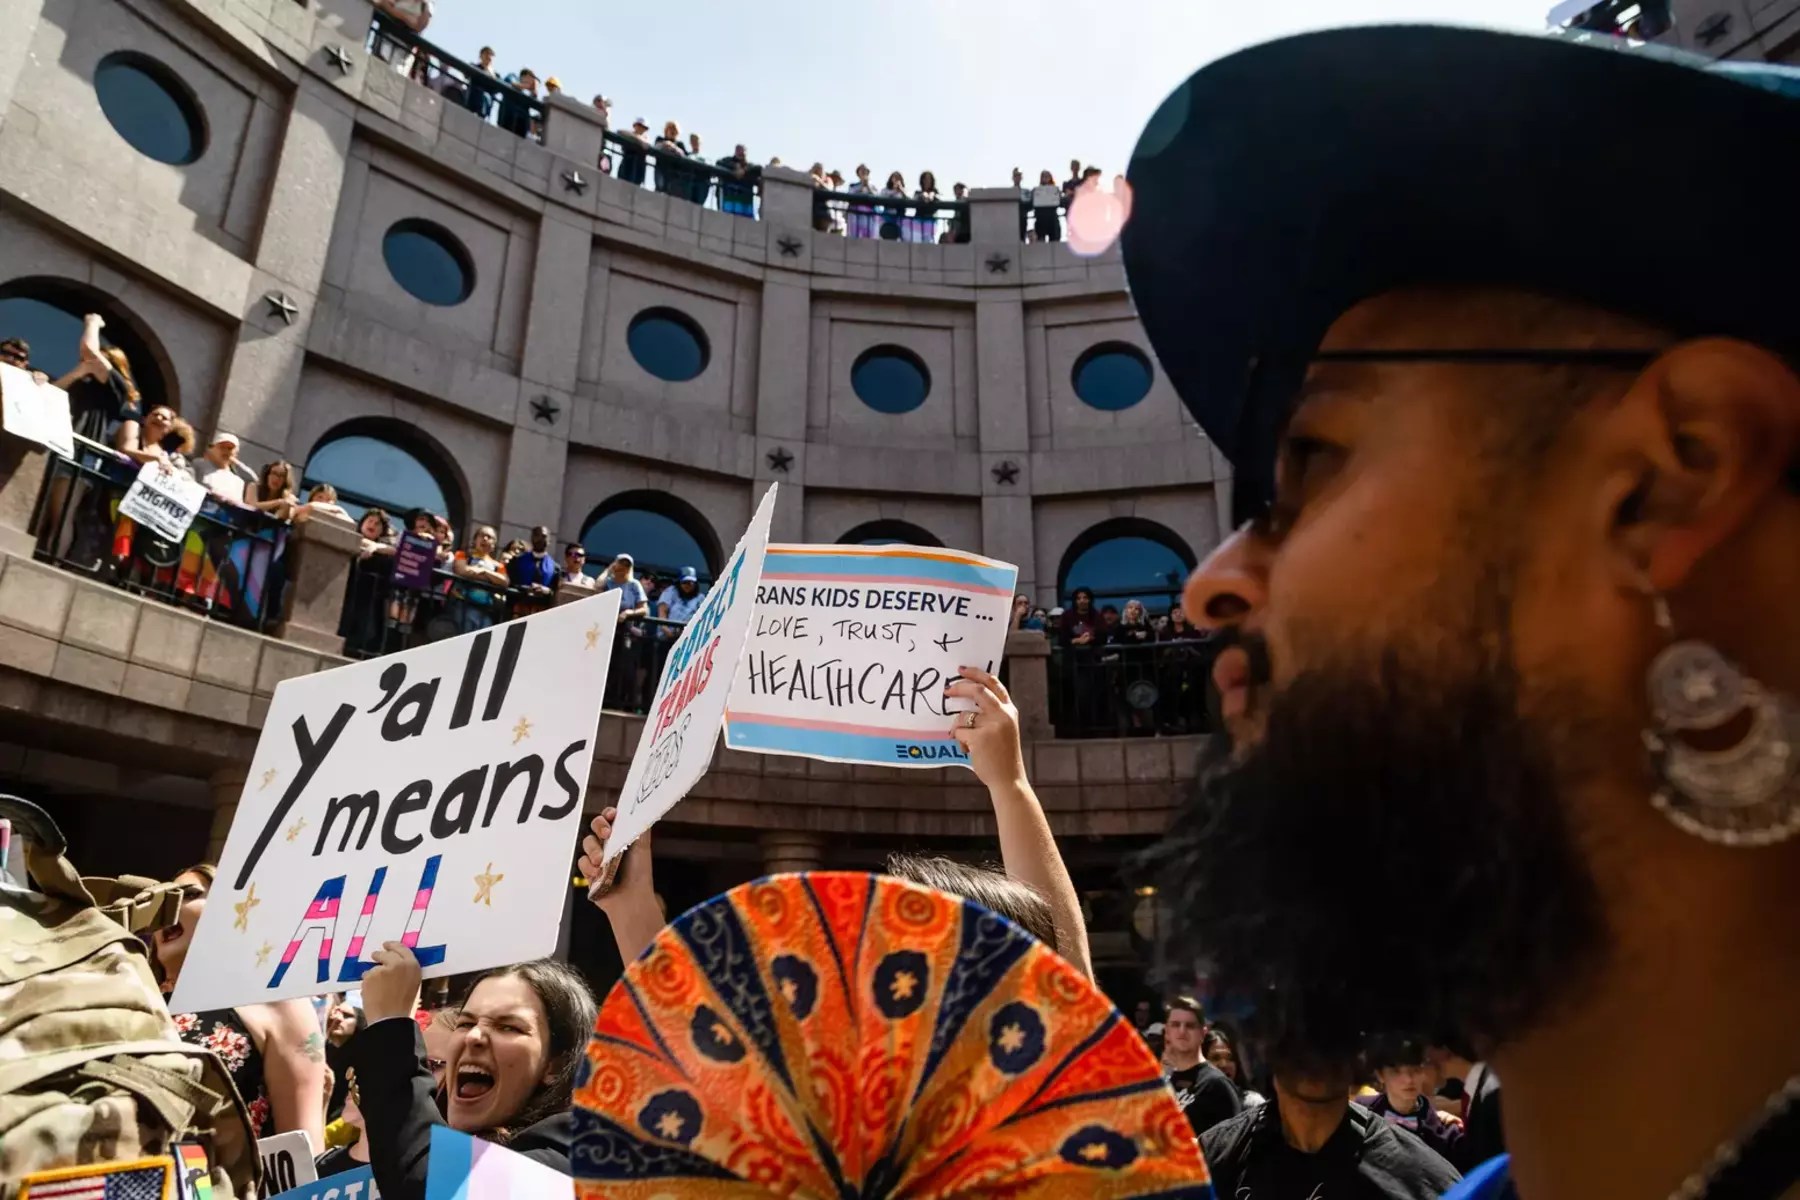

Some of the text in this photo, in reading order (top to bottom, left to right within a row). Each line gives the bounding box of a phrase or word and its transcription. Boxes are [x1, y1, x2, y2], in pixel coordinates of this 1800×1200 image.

[137, 485, 189, 521] RIGHTS!
[661, 548, 746, 698] PROTECT
[756, 586, 807, 606] RANS
[811, 588, 860, 609] KIDS
[832, 619, 917, 653] TRUST,
[650, 635, 721, 748] TRANS
[312, 739, 587, 856] means
[266, 853, 446, 988] ALL
